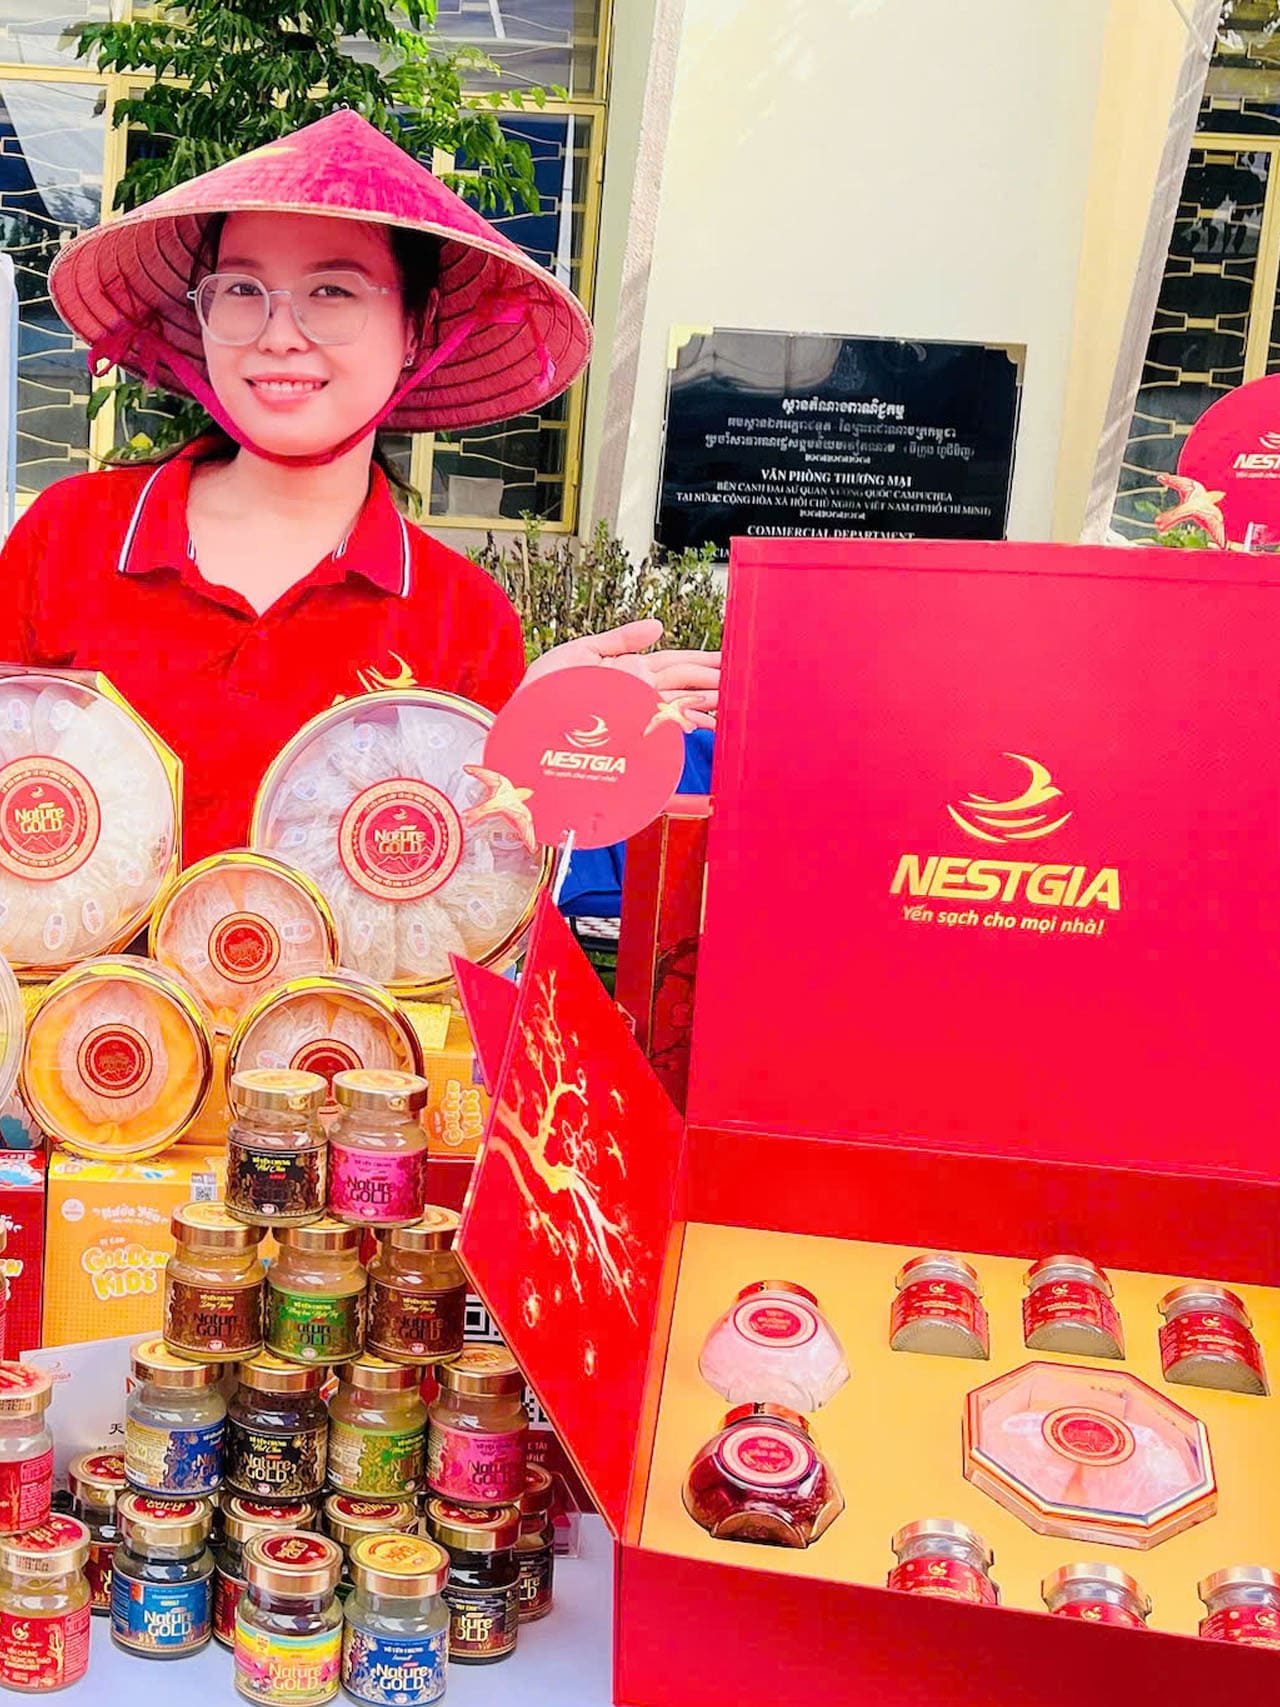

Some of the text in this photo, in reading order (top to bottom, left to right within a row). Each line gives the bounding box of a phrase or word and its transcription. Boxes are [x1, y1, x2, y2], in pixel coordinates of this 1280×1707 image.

[761, 467, 787, 481] VĂN
[789, 468, 831, 484] PHÒNG
[834, 472, 885, 486] THƯƠNG
[893, 490, 953, 501] CAMPUCHIA
[887, 502, 910, 512] NAM
[747, 525, 832, 538] COMMERCIAL
[540, 749, 626, 774] NESTGIA
[15, 806, 65, 823] Nature
[20, 819, 63, 834] GOLD
[374, 829, 426, 843] Nature
[379, 840, 422, 855] GOLD
[890, 854, 1121, 911] NESTGIA
[902, 903, 1104, 935] Yến sạch cho mọi nhà!
[350, 1189, 392, 1204] GOLD
[243, 1453, 293, 1471] Nature
[246, 1466, 288, 1483] GOLD
[147, 1622, 192, 1637] GOLD
[270, 1662, 320, 1680] Nature
[376, 1662, 428, 1680] Nature
[273, 1675, 319, 1691] GOLD
[379, 1676, 424, 1691] GOLD
